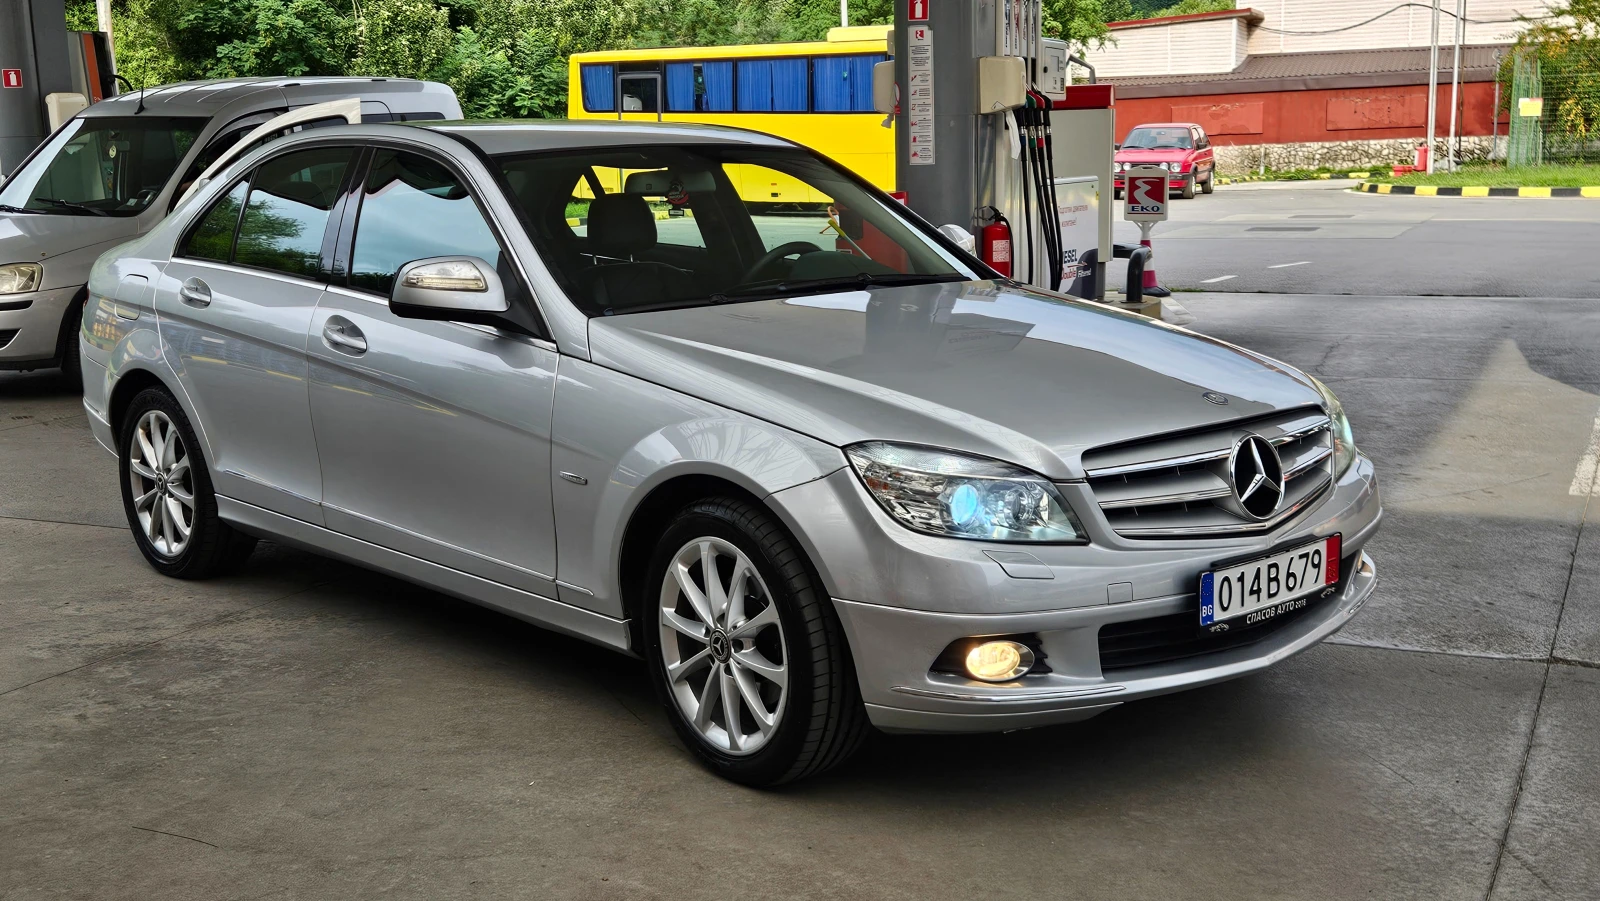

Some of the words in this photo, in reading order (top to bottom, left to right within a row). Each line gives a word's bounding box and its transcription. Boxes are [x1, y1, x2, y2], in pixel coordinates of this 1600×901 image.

[1219, 549, 1322, 612] 014B679
[1202, 605, 1213, 617] BG
[1246, 607, 1275, 624] СПАСОВ
